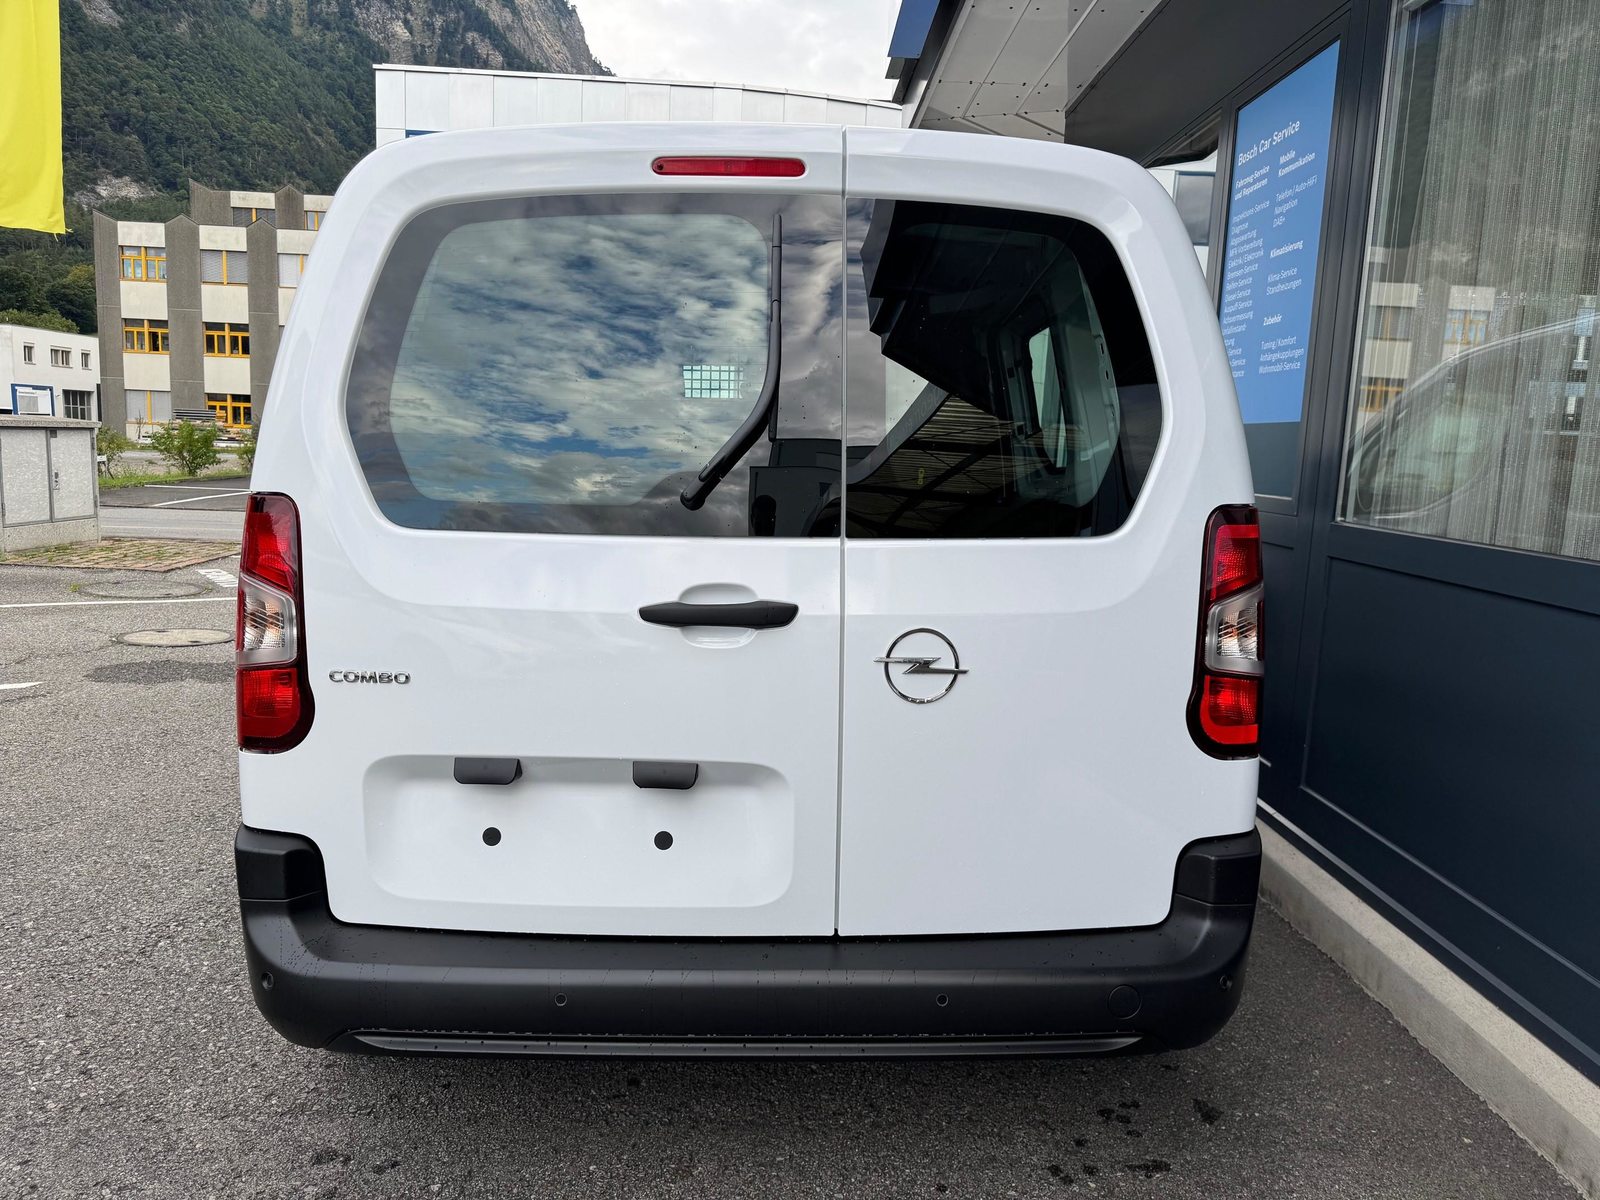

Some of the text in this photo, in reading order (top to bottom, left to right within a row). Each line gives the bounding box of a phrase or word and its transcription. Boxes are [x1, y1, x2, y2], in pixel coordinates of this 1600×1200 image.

[1238, 121, 1300, 166] Bosch Car Service
[1278, 152, 1316, 178] Kommunikation
[1279, 150, 1296, 165] Mobile
[1235, 165, 1270, 190] Fahrzeug-Service
[1234, 178, 1268, 201] und Reparaturen
[1275, 188, 1292, 203] Telefon
[1274, 199, 1298, 215] Navigation
[1231, 222, 1249, 235] Diagnose
[1272, 215, 1286, 228] DAB+
[1270, 240, 1304, 259] Klimatisierung
[1267, 266, 1298, 283] Klima-Service
[1266, 278, 1302, 296] Standheizungen
[1263, 313, 1282, 326] Zubehör
[1261, 340, 1277, 351] Tuning
[1278, 335, 1297, 348] Komfort
[1260, 347, 1304, 363] Anhängekupplungen
[1259, 360, 1301, 375] Wohnmobil-Service
[329, 670, 411, 685] COMBO
